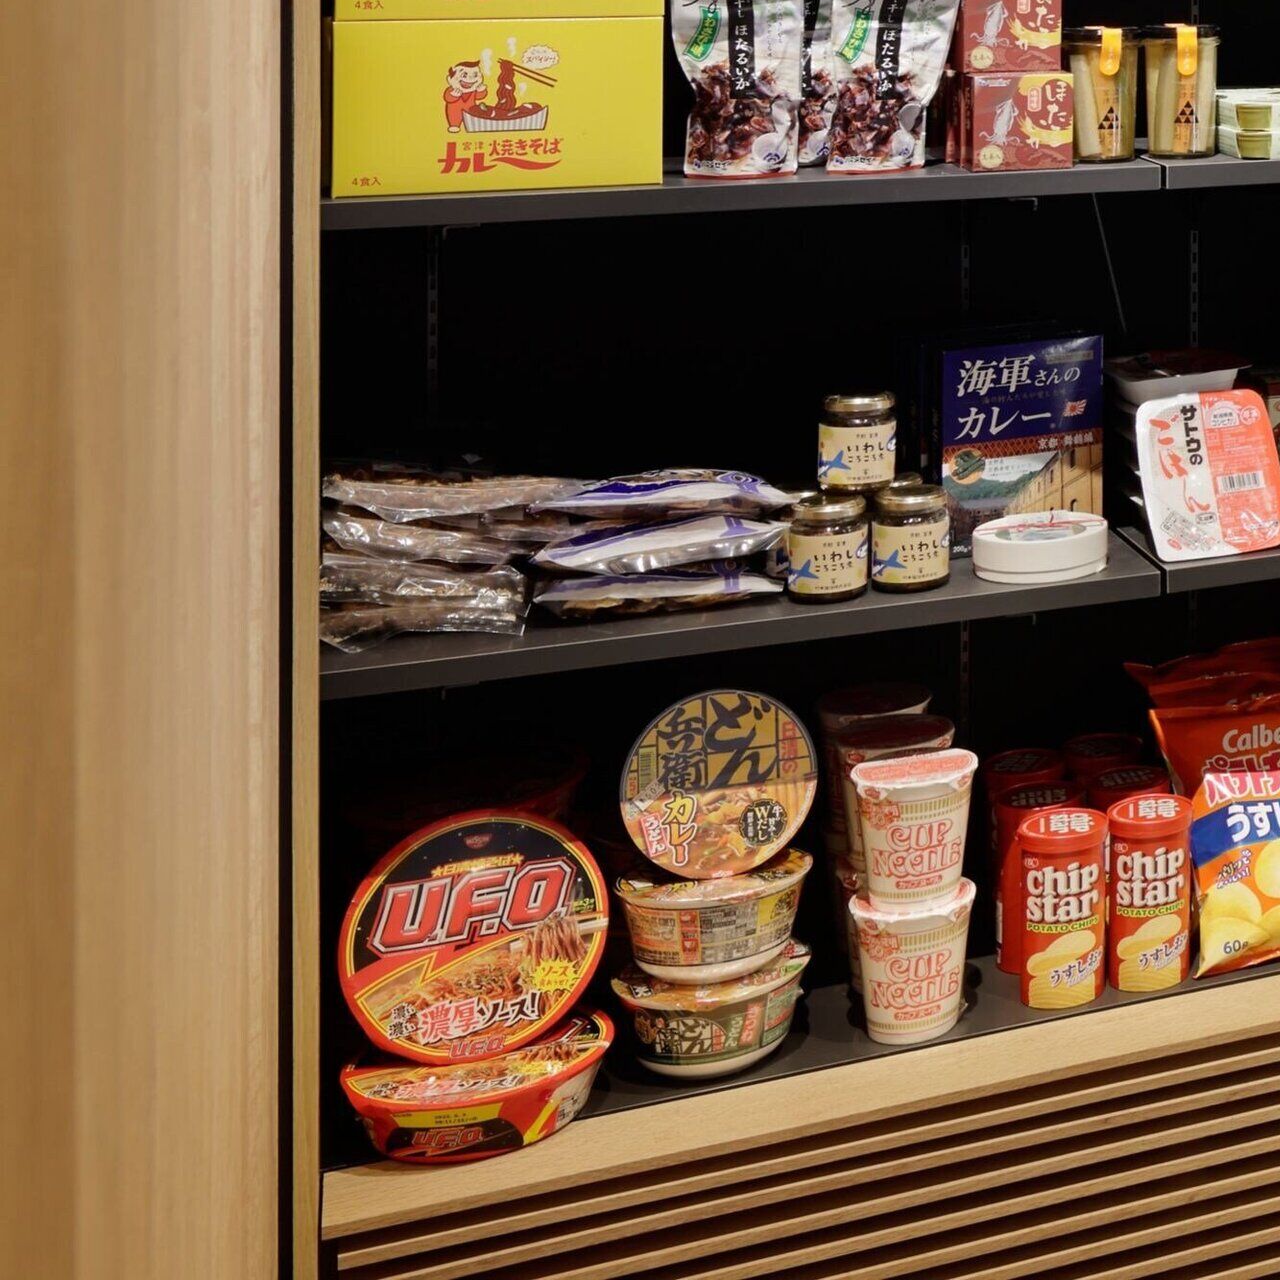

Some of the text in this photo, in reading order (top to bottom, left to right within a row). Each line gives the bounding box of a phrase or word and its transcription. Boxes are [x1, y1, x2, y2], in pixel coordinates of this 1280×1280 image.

[354, 0, 385, 10] 4食入
[734, 25, 750, 90] ほたるいか
[877, 30, 897, 94] ほたるいか
[437, 141, 563, 174] カレー
[488, 138, 564, 157] 焼きそば
[351, 177, 382, 187] 4食入
[957, 354, 1080, 397] 海軍さんの
[954, 406, 1052, 440] カレー
[1180, 405, 1203, 466] サトウの
[847, 441, 885, 454] いわし
[1149, 414, 1211, 513] ごはん
[814, 550, 853, 562] いわし
[901, 539, 940, 552] いわし
[656, 705, 705, 793] 兵衛
[704, 692, 780, 790] どん
[644, 815, 667, 856] うどん
[661, 790, 698, 867] カレー
[887, 819, 953, 853] CUP
[871, 836, 962, 878] NOODLE
[1026, 889, 1099, 923] star
[1116, 874, 1185, 908] star
[1027, 917, 1099, 933] POTATO CHIPS
[1117, 906, 1158, 916] POTATO
[541, 966, 569, 978] ソース
[888, 948, 952, 983] CUP
[870, 966, 961, 1009] NOODLE
[420, 992, 542, 1045] 濃厚ソース!
